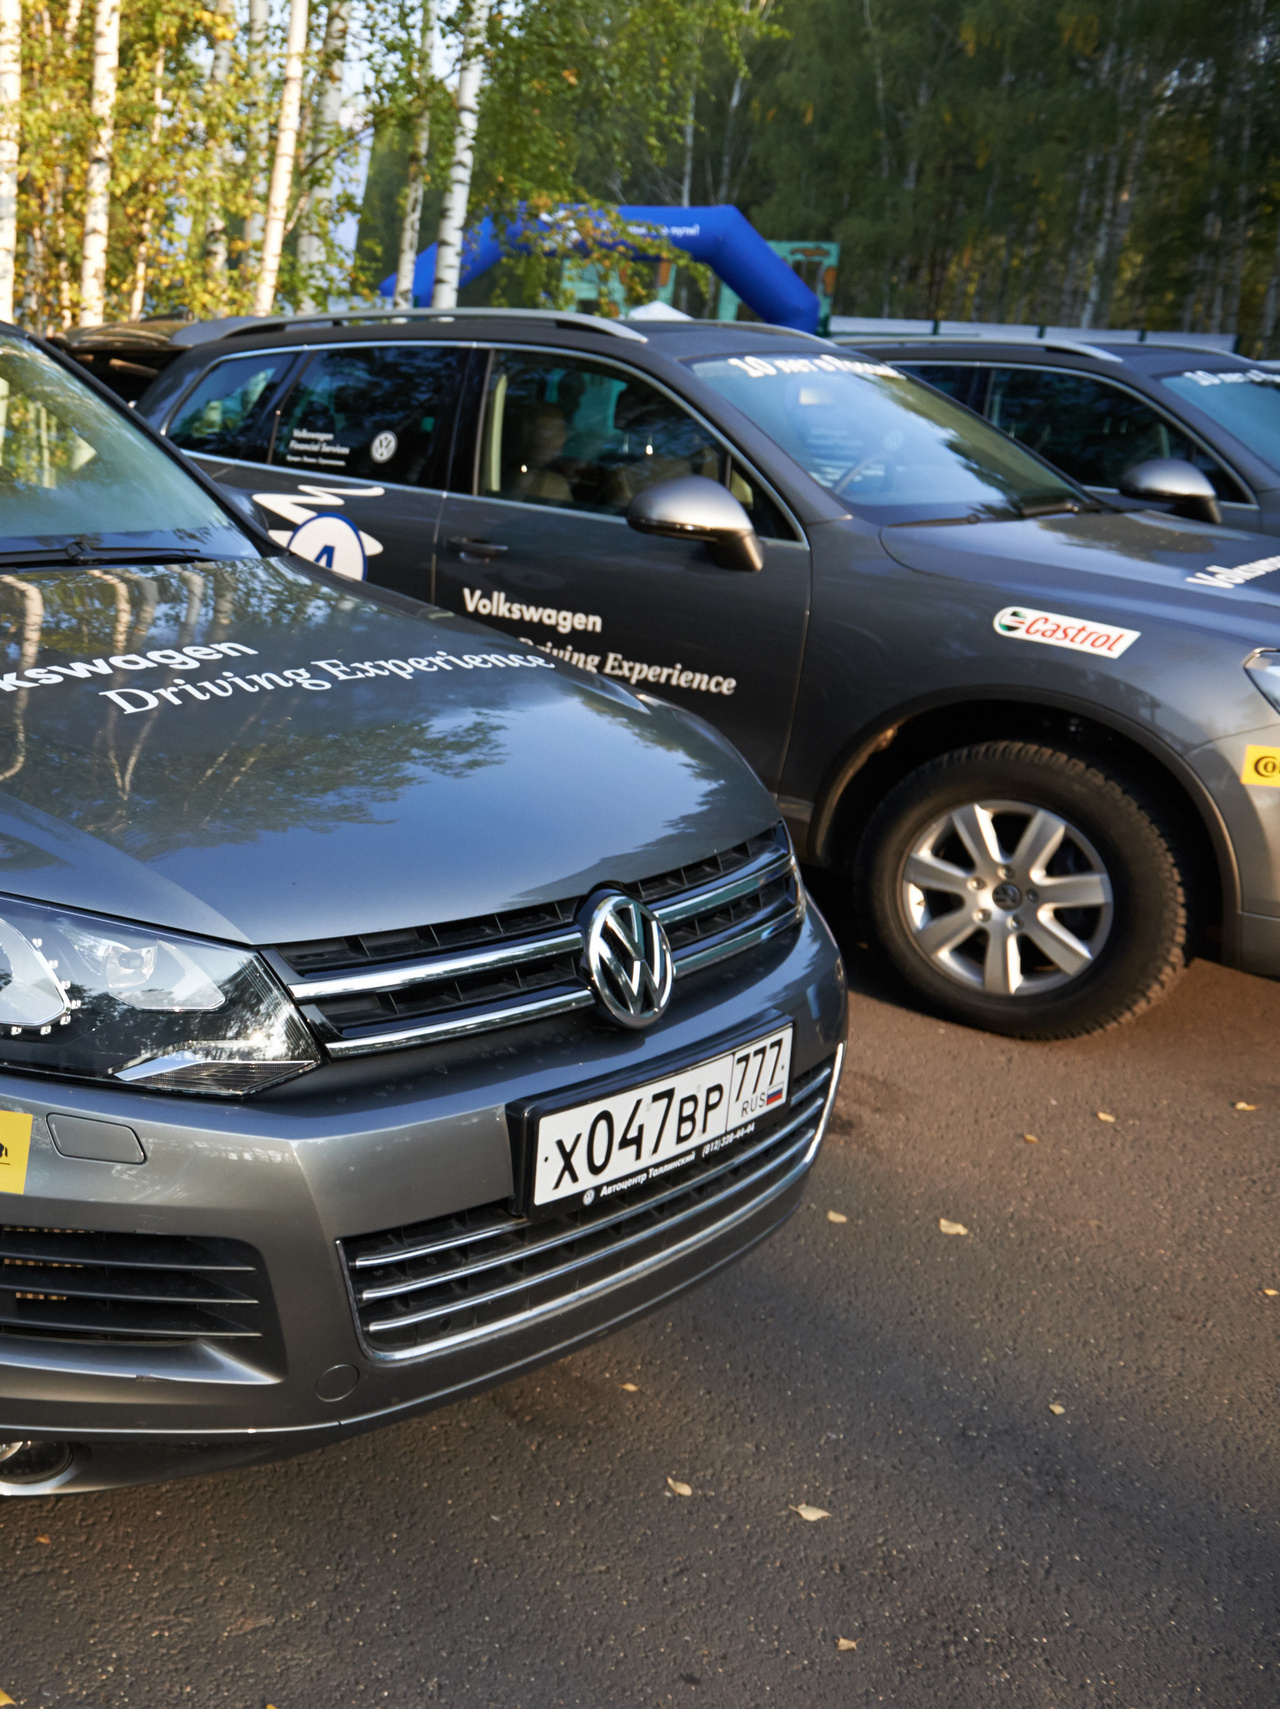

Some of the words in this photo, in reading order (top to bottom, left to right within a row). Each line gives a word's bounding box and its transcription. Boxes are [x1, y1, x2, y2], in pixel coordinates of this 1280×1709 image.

[463, 587, 602, 634] Volkswagen
[1025, 616, 1124, 652] Castrol
[98, 668, 332, 715] Driving
[310, 651, 555, 681] Experience
[603, 652, 737, 695] Experience
[736, 1038, 783, 1102] 777
[741, 1091, 767, 1118] RUS
[600, 1170, 648, 1197] Автоцентр
[648, 1151, 696, 1179] Таллинский
